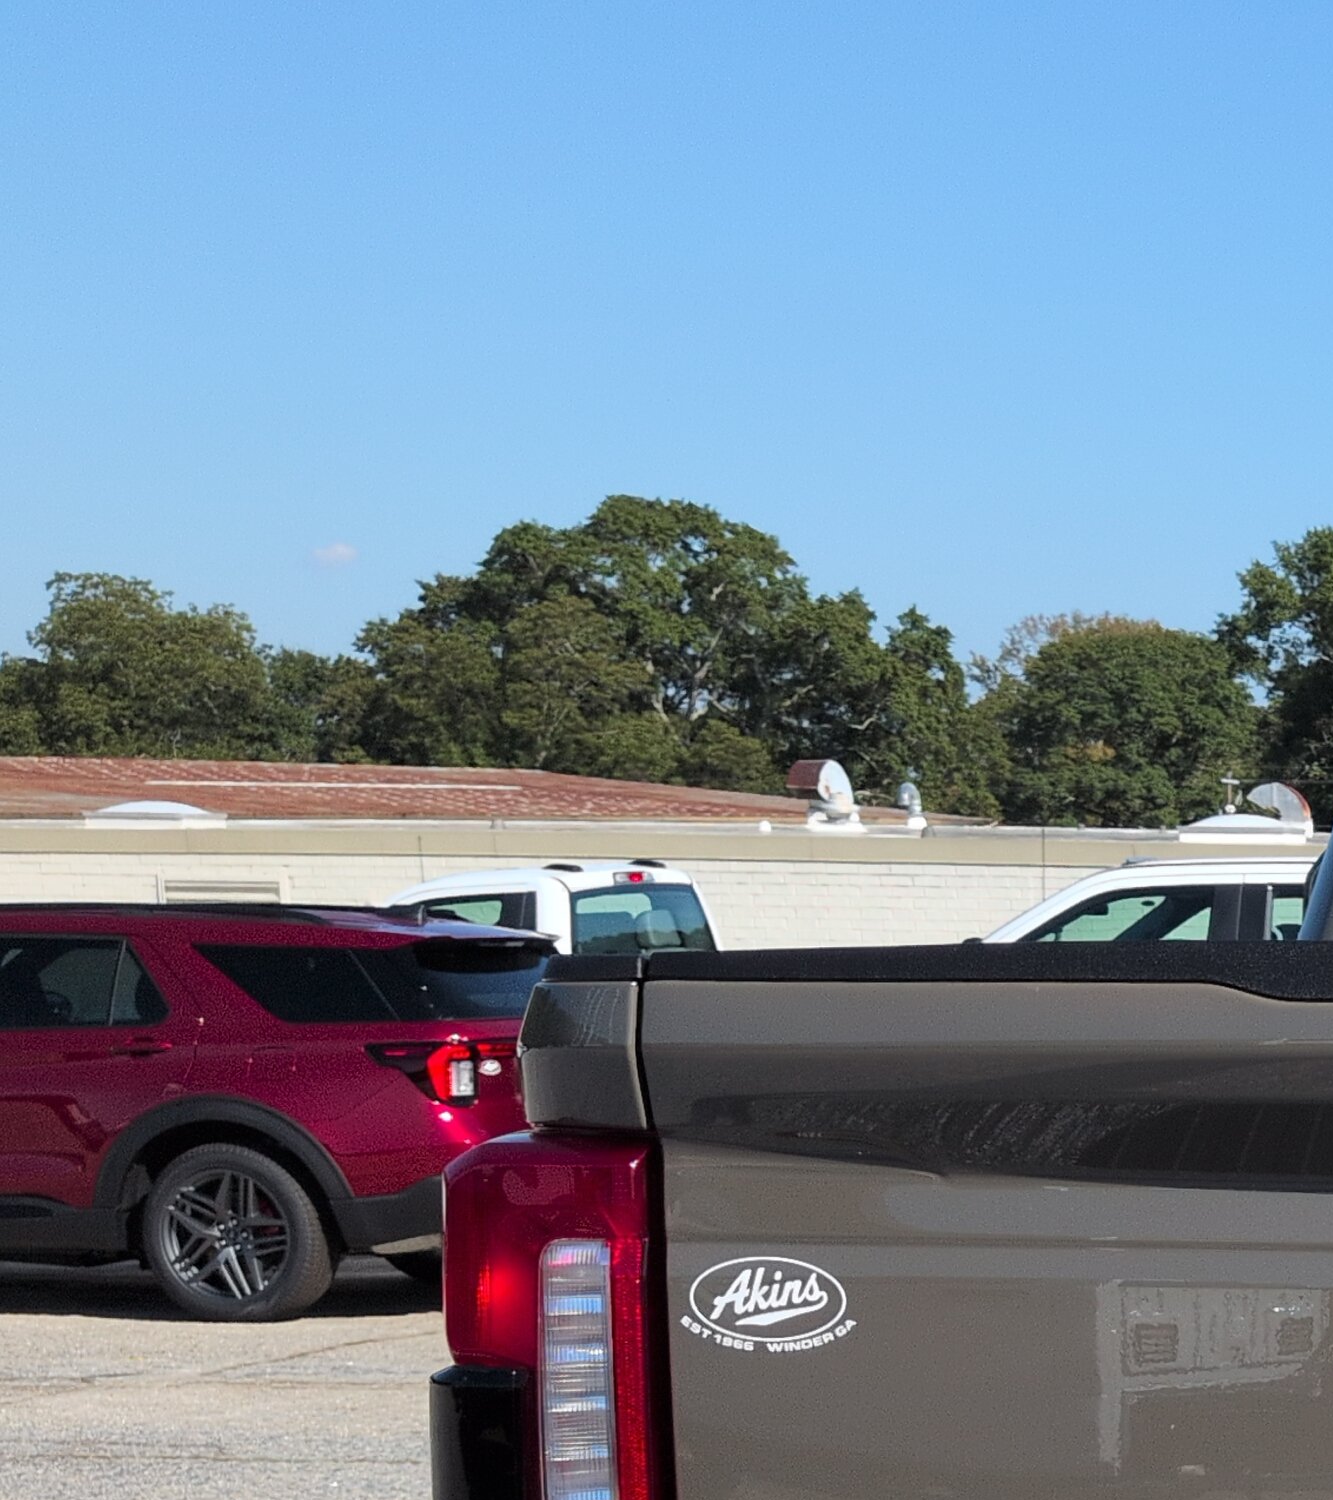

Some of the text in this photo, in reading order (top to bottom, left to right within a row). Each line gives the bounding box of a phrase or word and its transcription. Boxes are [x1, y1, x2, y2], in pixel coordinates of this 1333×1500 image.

[709, 1267, 828, 1321] Akins
[680, 1315, 857, 1352] EST 1966 WINDER GA
